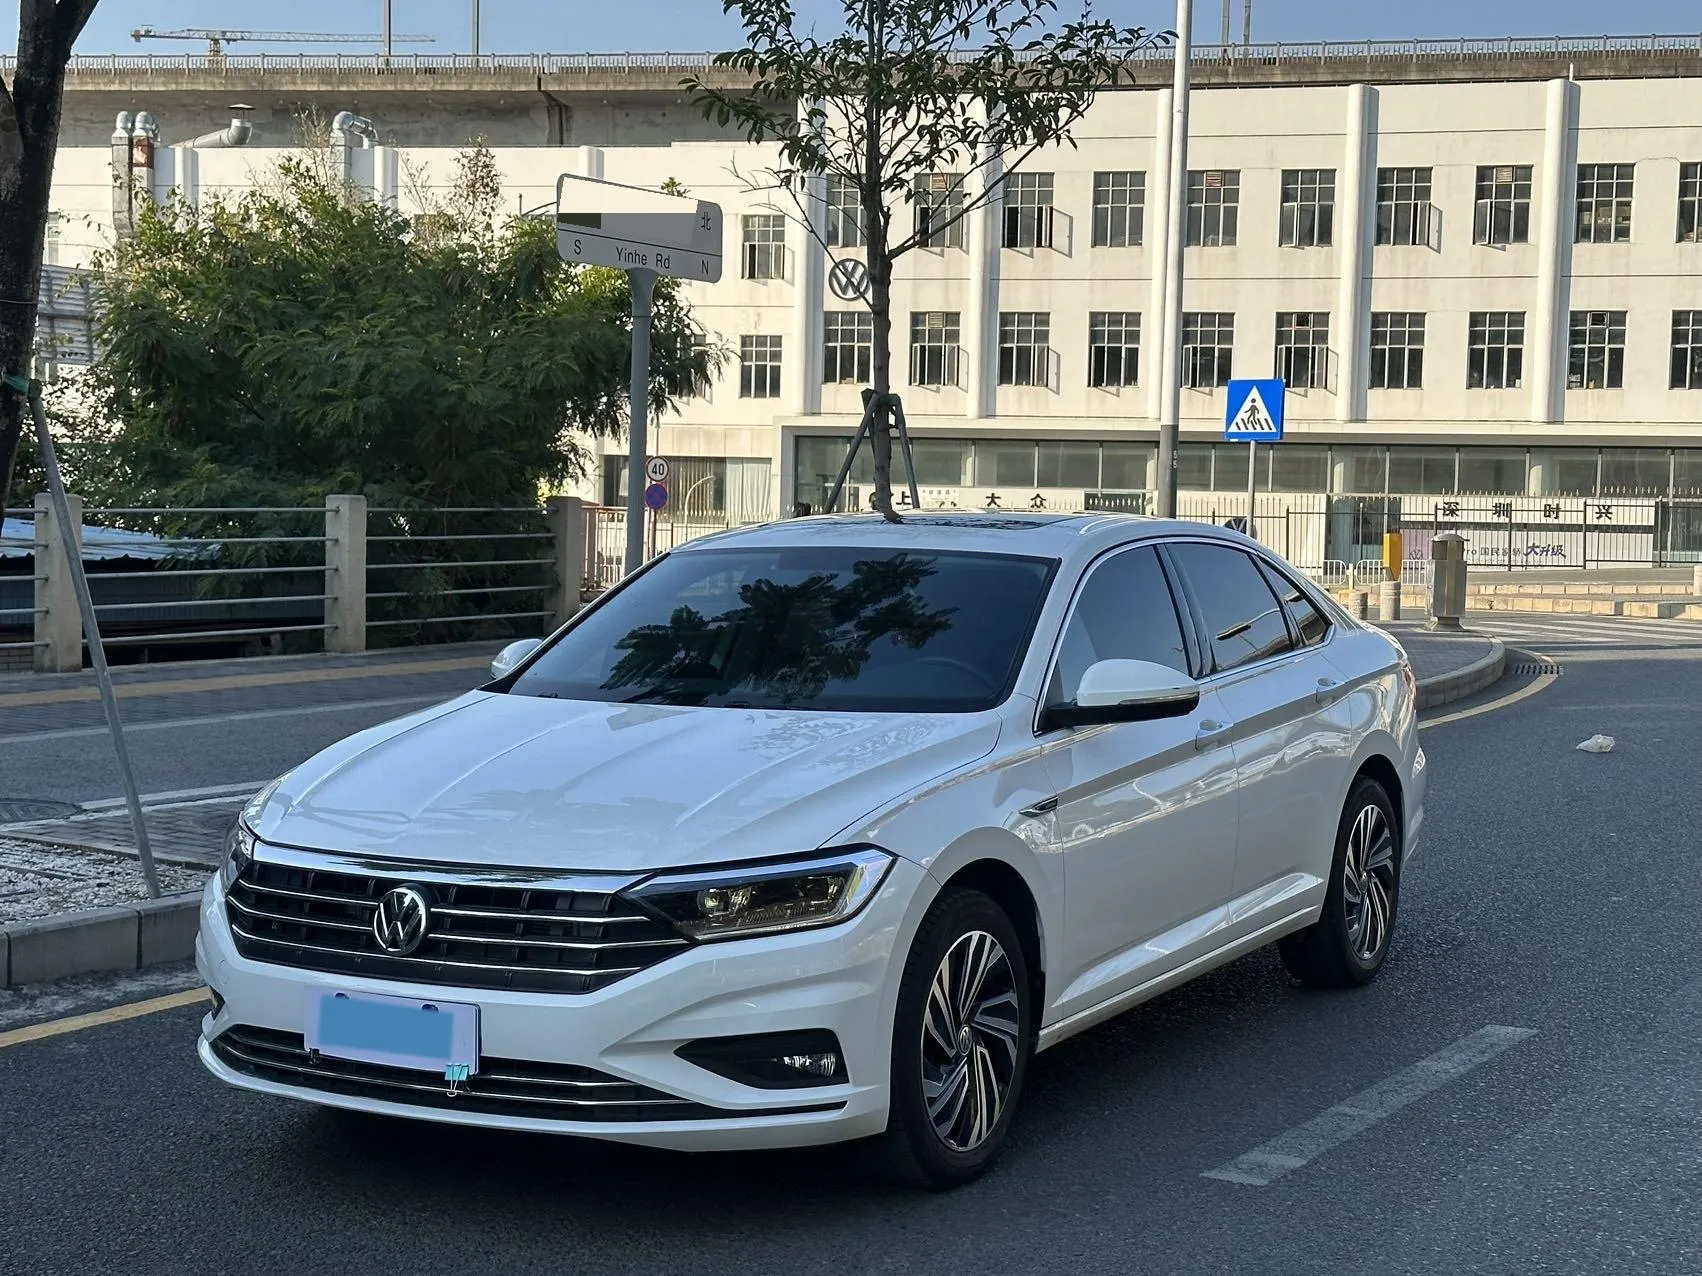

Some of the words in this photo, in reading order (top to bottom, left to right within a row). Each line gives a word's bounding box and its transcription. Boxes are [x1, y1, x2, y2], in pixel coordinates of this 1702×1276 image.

[701, 211, 712, 231] 北
[574, 239, 582, 255] S
[616, 246, 648, 265] Yinhe
[655, 253, 670, 269] Rd
[701, 260, 709, 275] N
[652, 463, 665, 475] 40
[896, 491, 1047, 509] 上大众
[374, 886, 426, 955] VW
